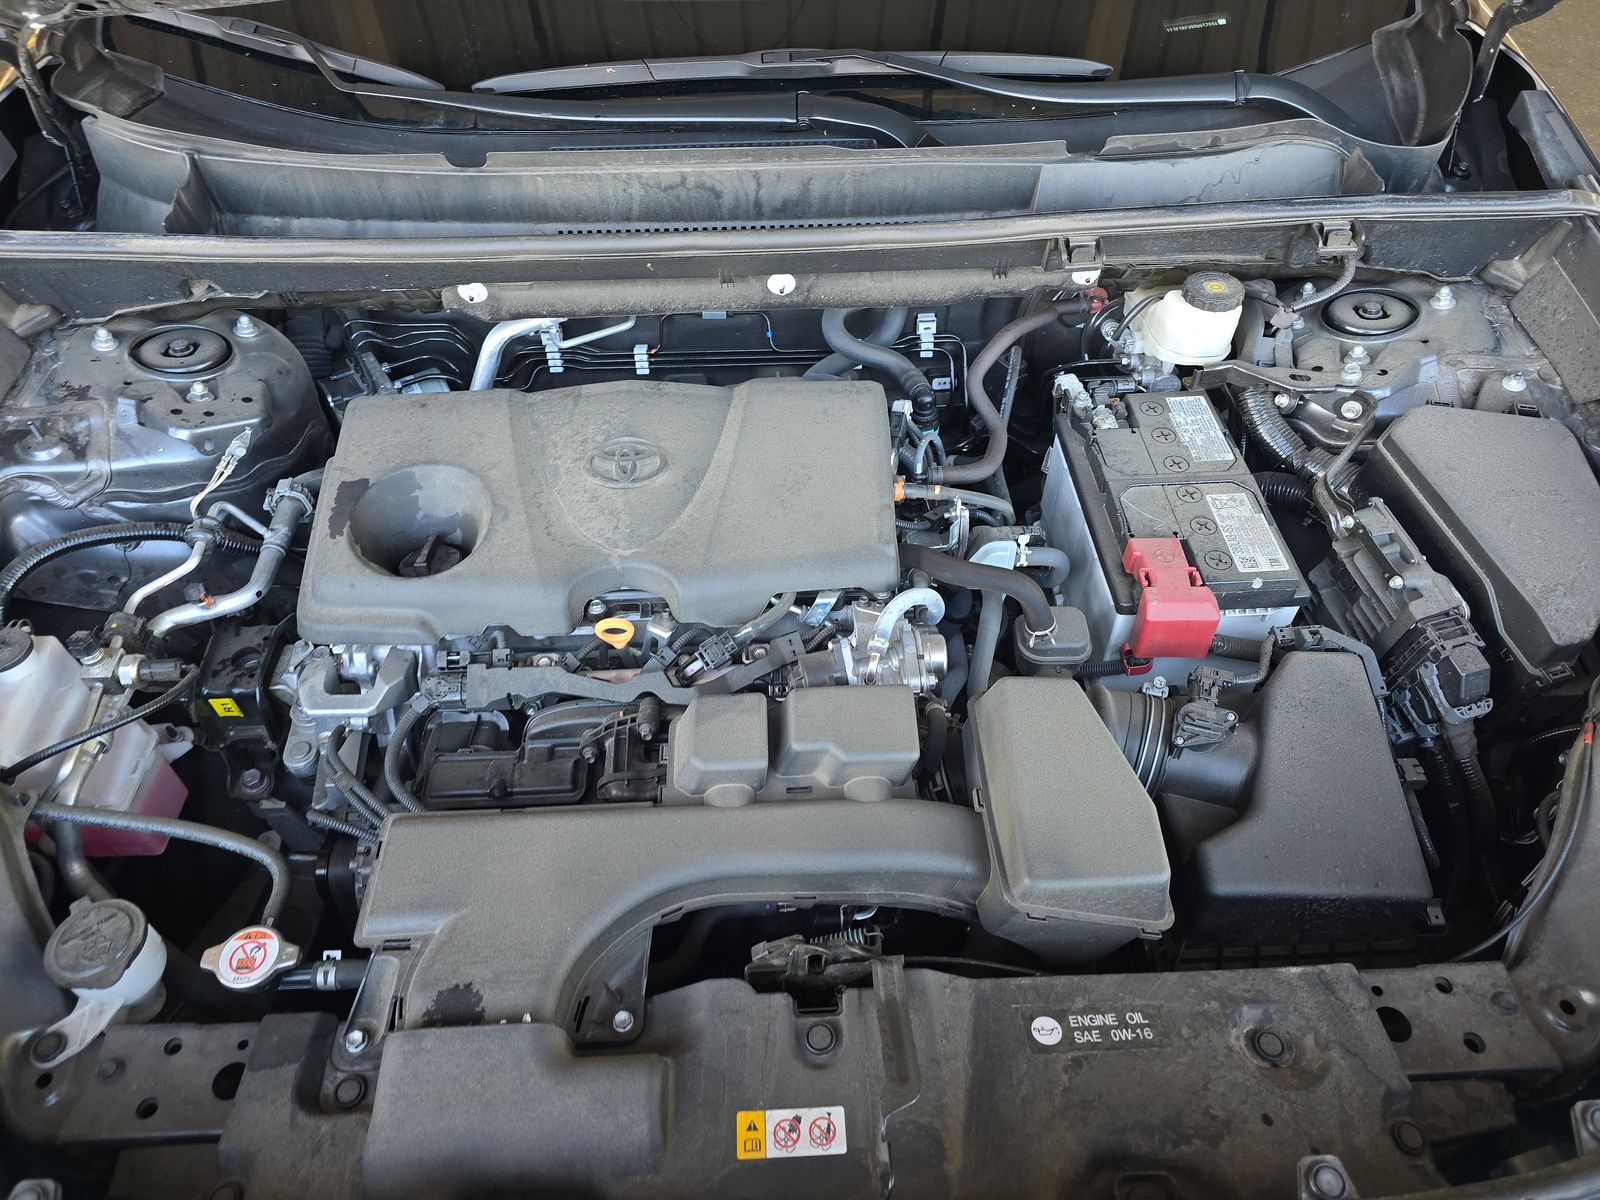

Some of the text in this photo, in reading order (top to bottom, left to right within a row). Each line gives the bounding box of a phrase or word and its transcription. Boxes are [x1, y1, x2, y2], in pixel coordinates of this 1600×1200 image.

[1068, 1012, 1149, 1027] ENGINE OIL
[1073, 1027, 1153, 1043] SAE 0W-16
